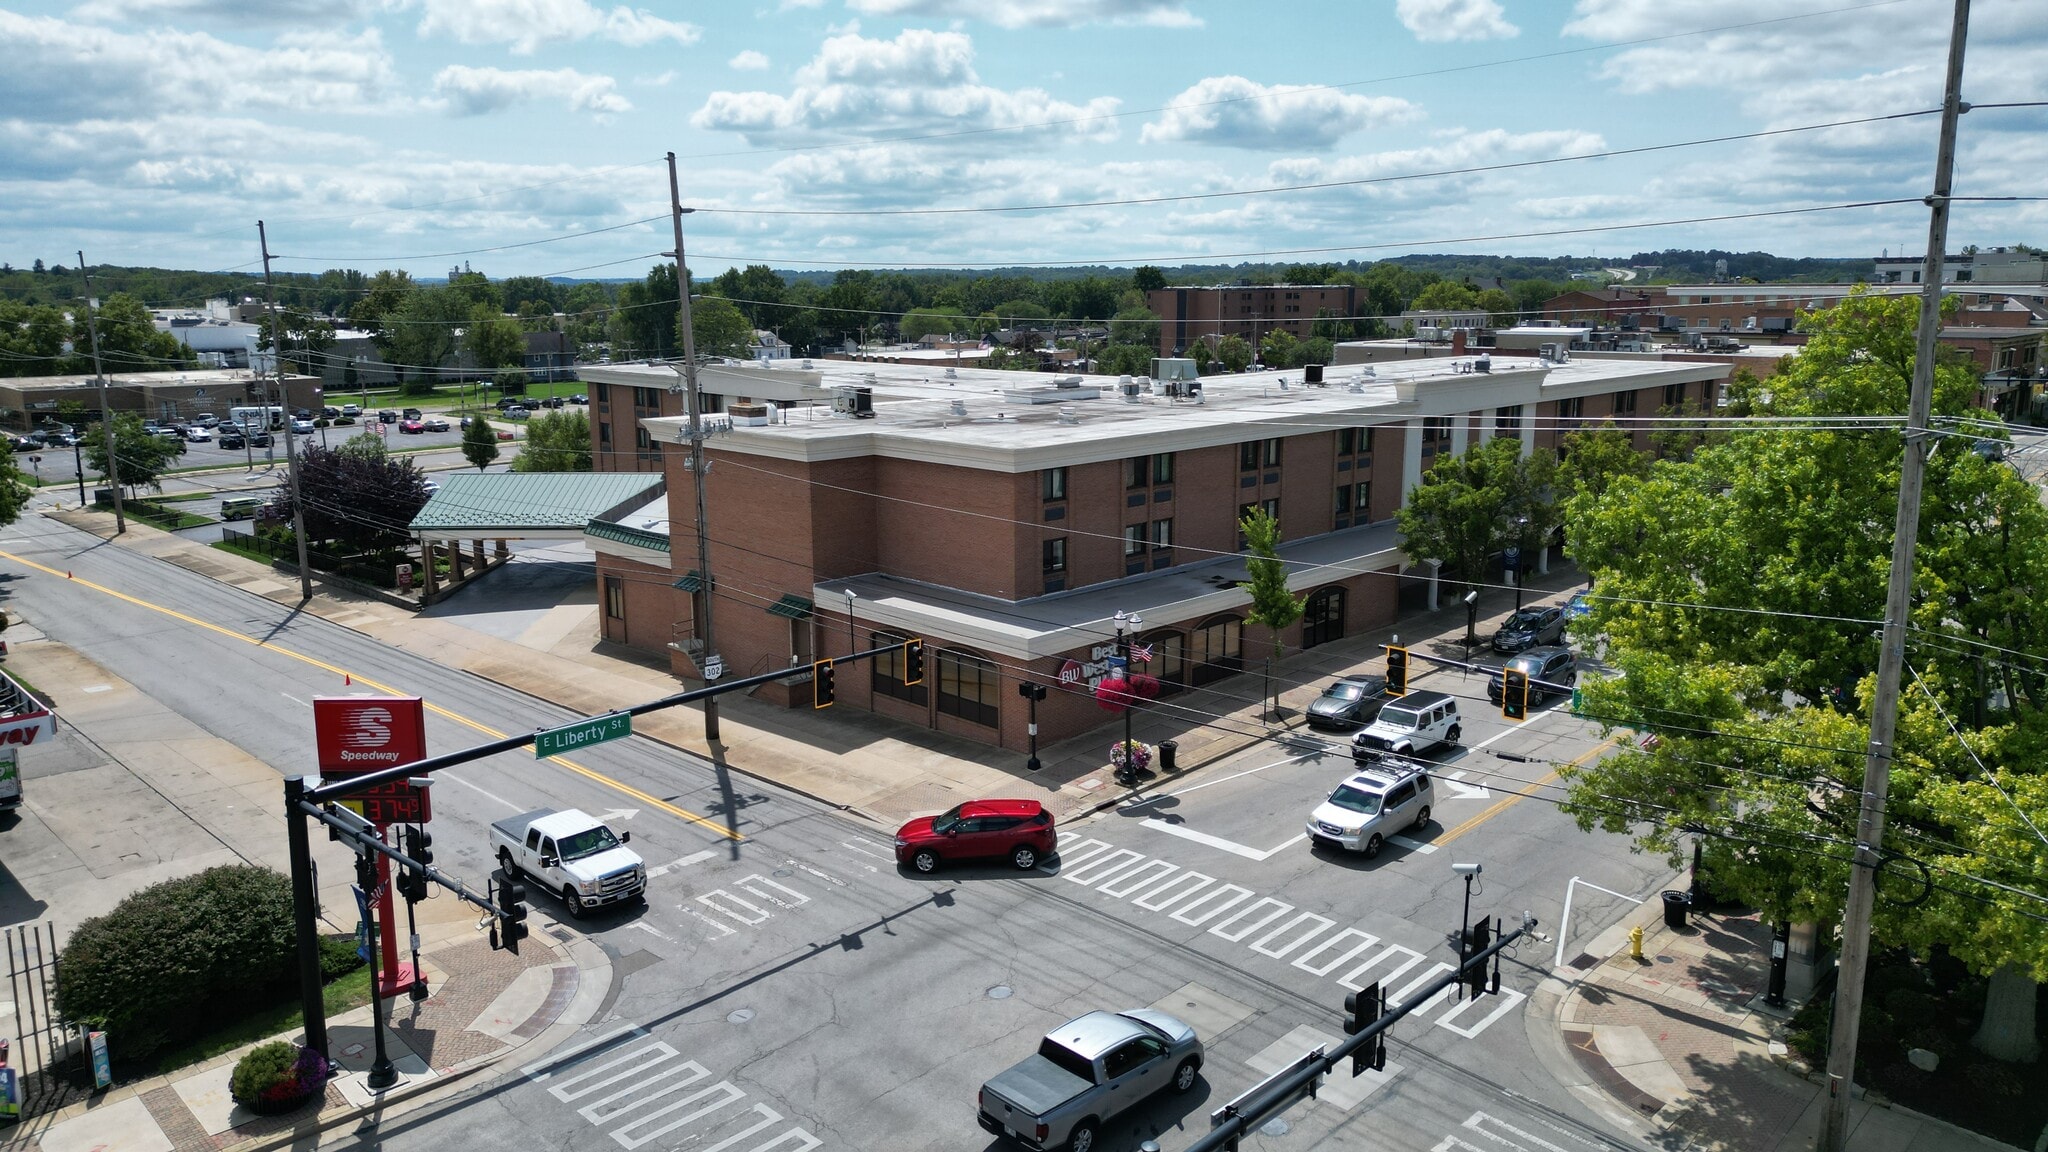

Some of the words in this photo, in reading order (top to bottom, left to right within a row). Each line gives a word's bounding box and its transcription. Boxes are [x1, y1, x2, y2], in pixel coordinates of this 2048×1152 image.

[1092, 643, 1118, 661] Best
[707, 666, 720, 677] 302
[1062, 667, 1080, 685] BW
[1082, 660, 1109, 678] West
[543, 737, 550, 747] E
[556, 725, 606, 748] Liberty
[611, 719, 625, 730] St.
[340, 750, 400, 762] Speedway
